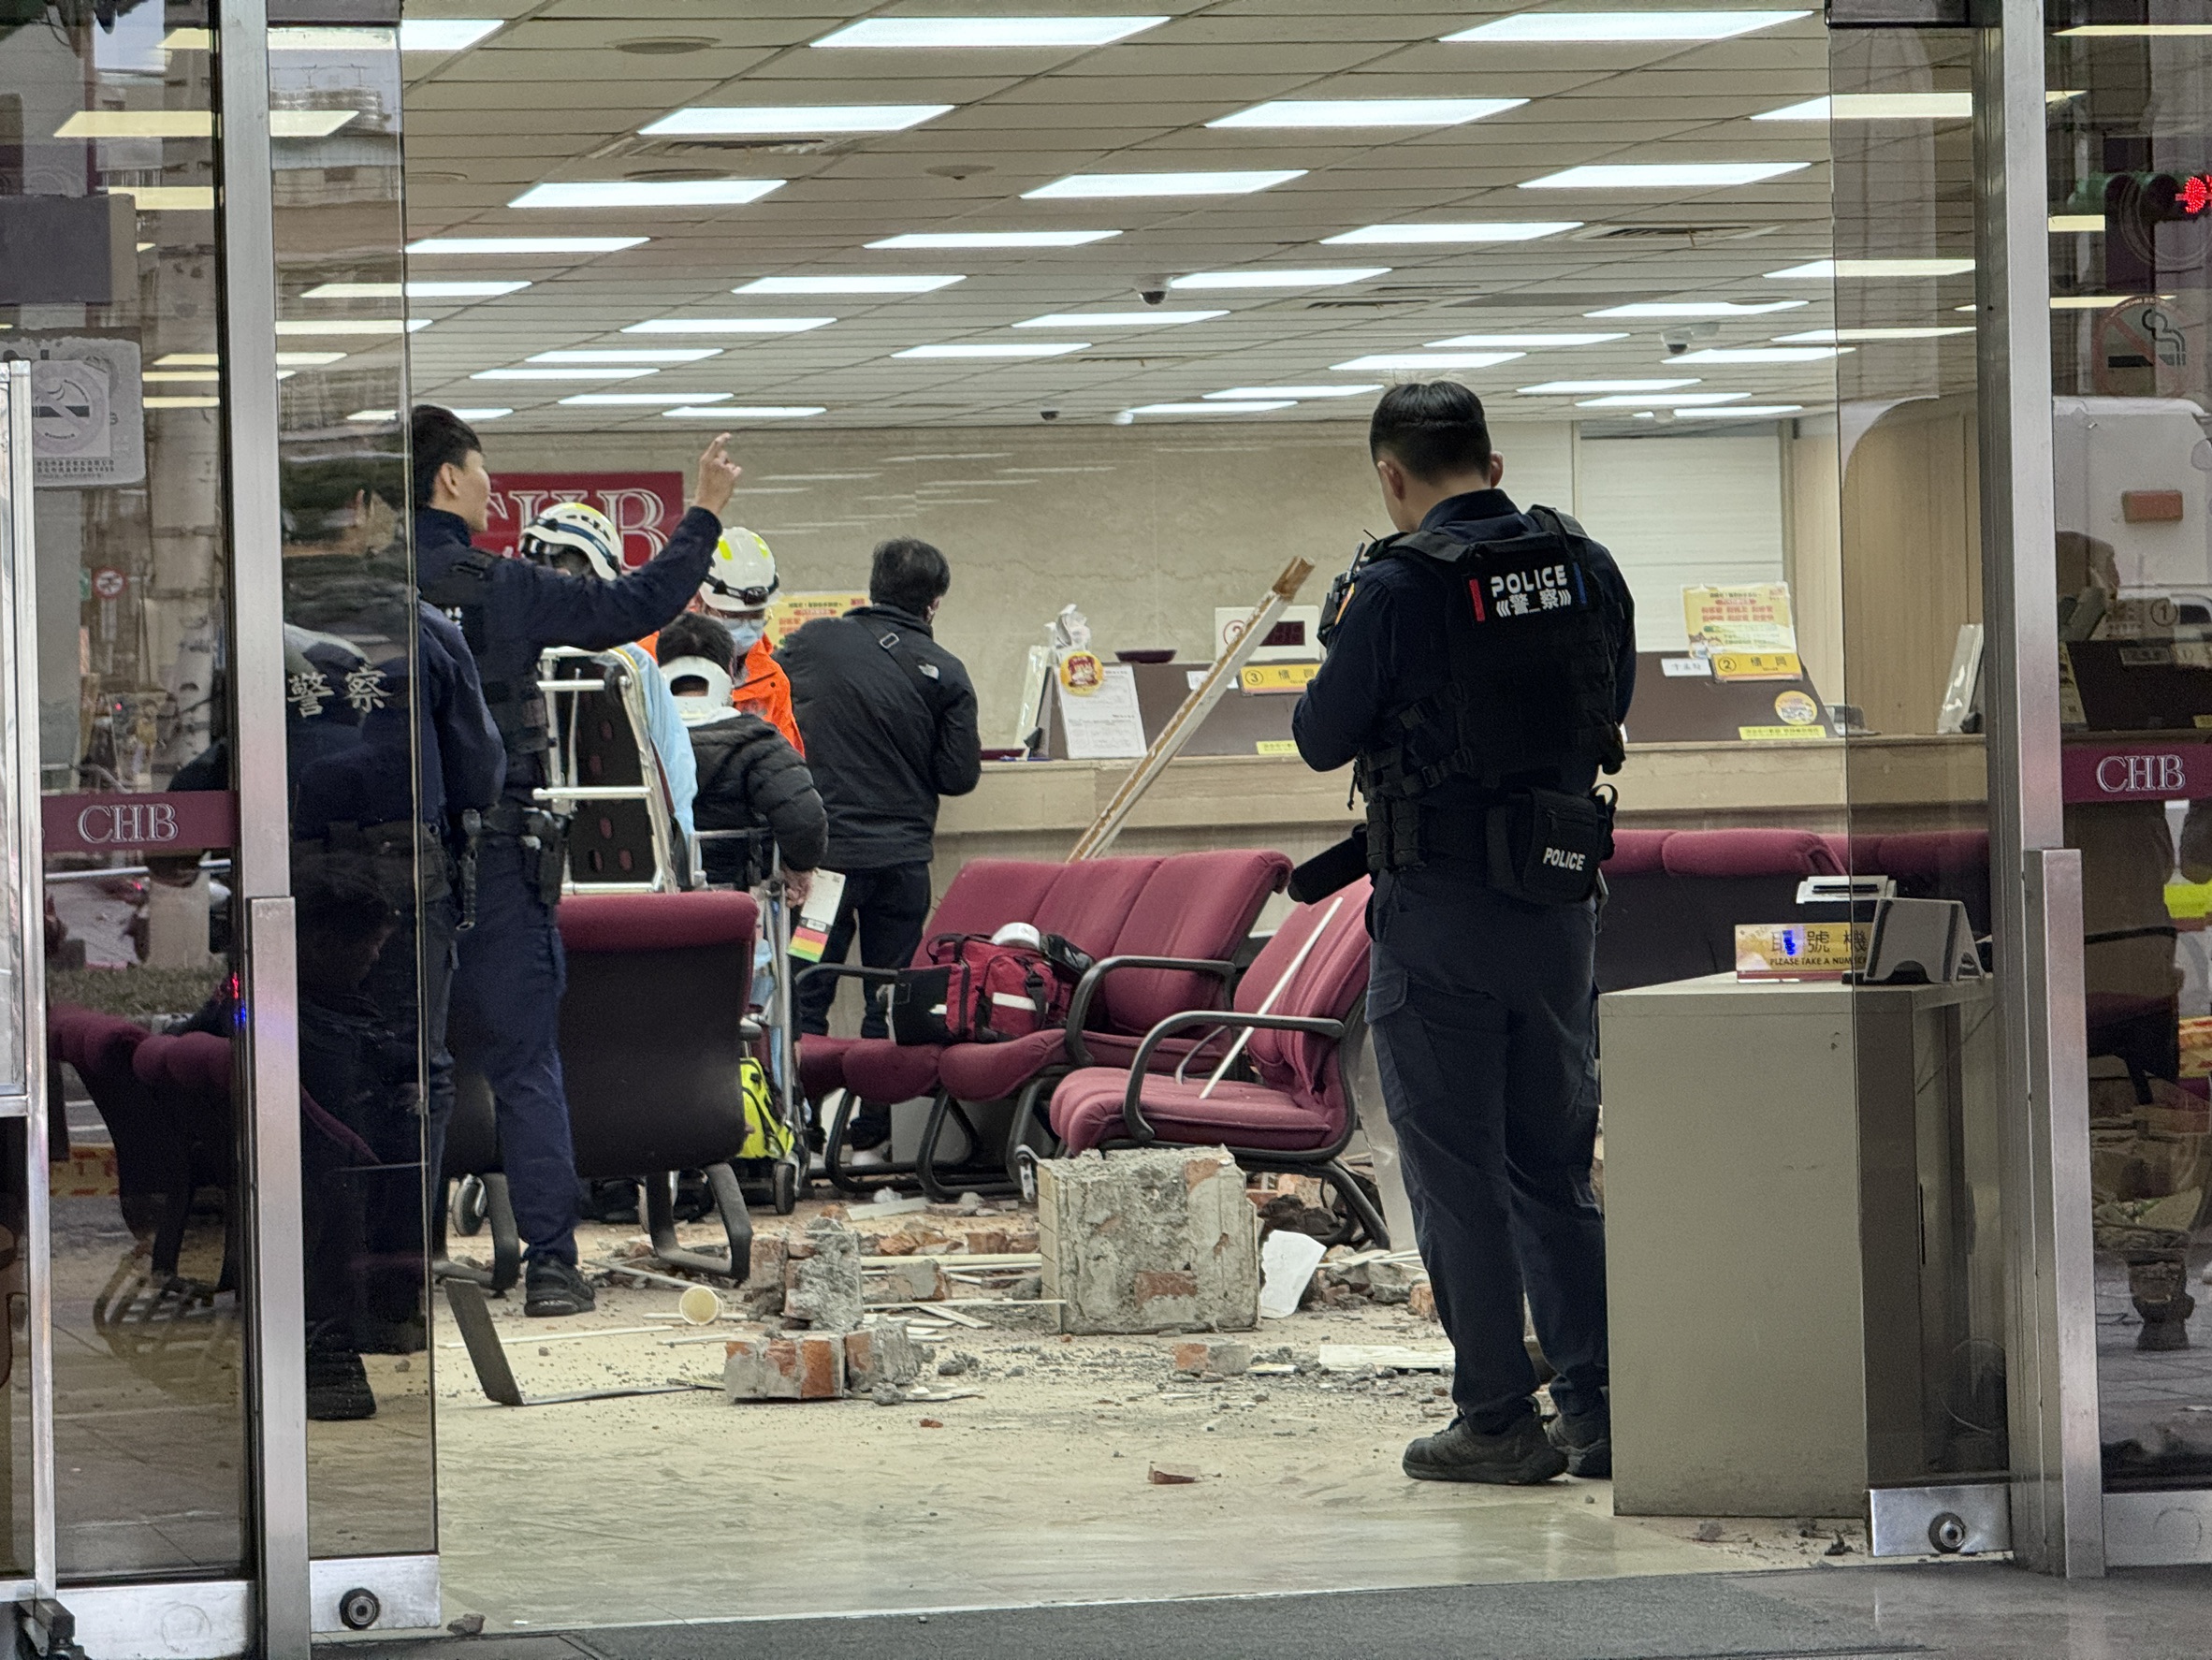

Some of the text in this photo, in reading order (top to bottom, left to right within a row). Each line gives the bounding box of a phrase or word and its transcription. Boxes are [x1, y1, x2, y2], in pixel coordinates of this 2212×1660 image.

[1491, 564, 1567, 598] POLICE
[287, 663, 392, 718] 警察
[2096, 754, 2186, 793] CHB
[78, 803, 179, 843] CHB
[1543, 847, 1585, 871] POLICE
[1801, 957, 1821, 966] TAKE
